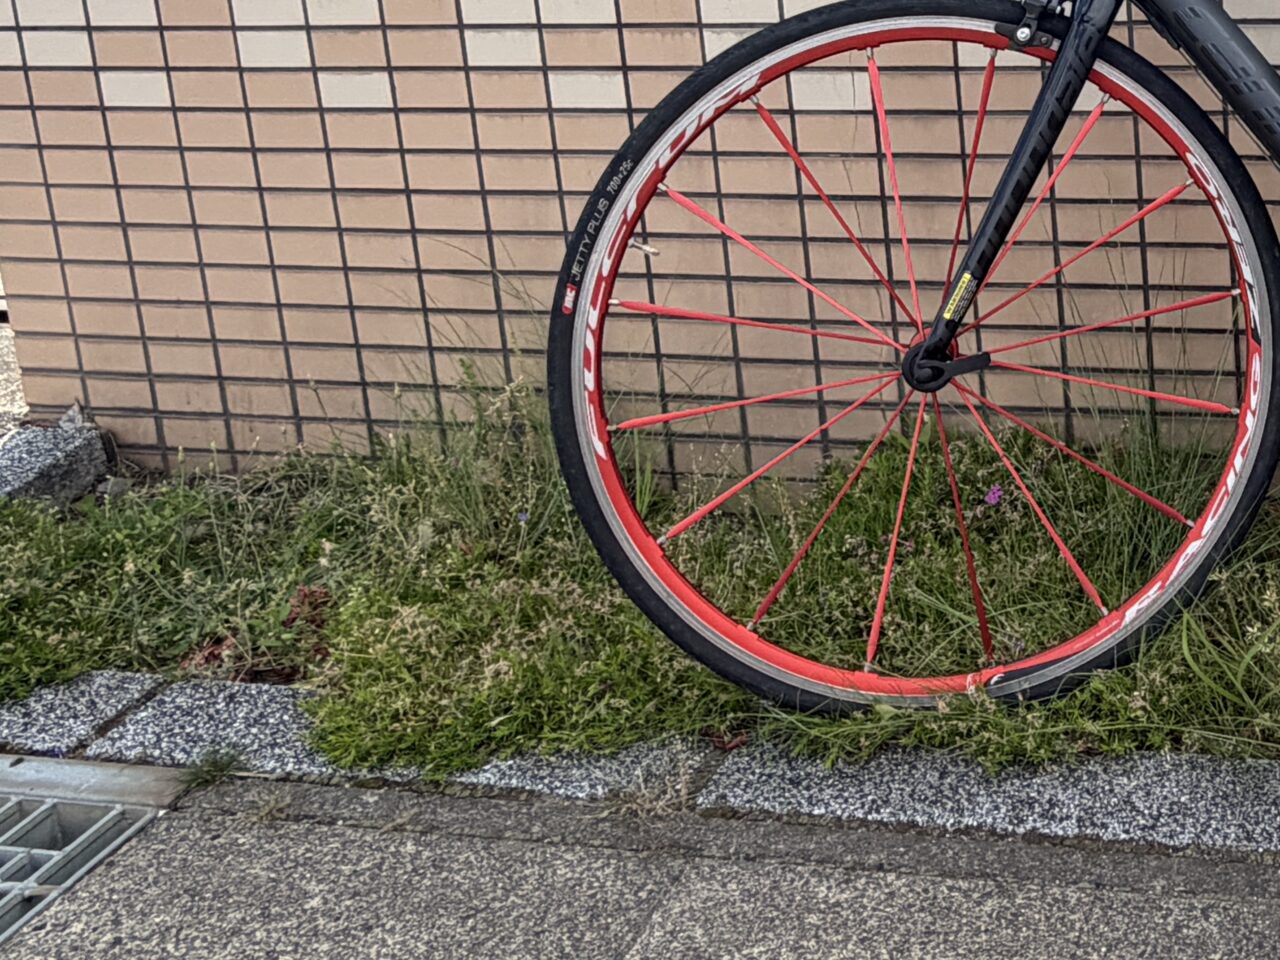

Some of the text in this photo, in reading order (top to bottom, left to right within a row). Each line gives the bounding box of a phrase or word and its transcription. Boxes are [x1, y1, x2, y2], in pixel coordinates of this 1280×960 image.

[570, 232, 592, 281] JETTY
[587, 197, 609, 235] PLUS
[584, 73, 760, 459] FULCRUM
[1120, 151, 1262, 629] RACING ZERO
